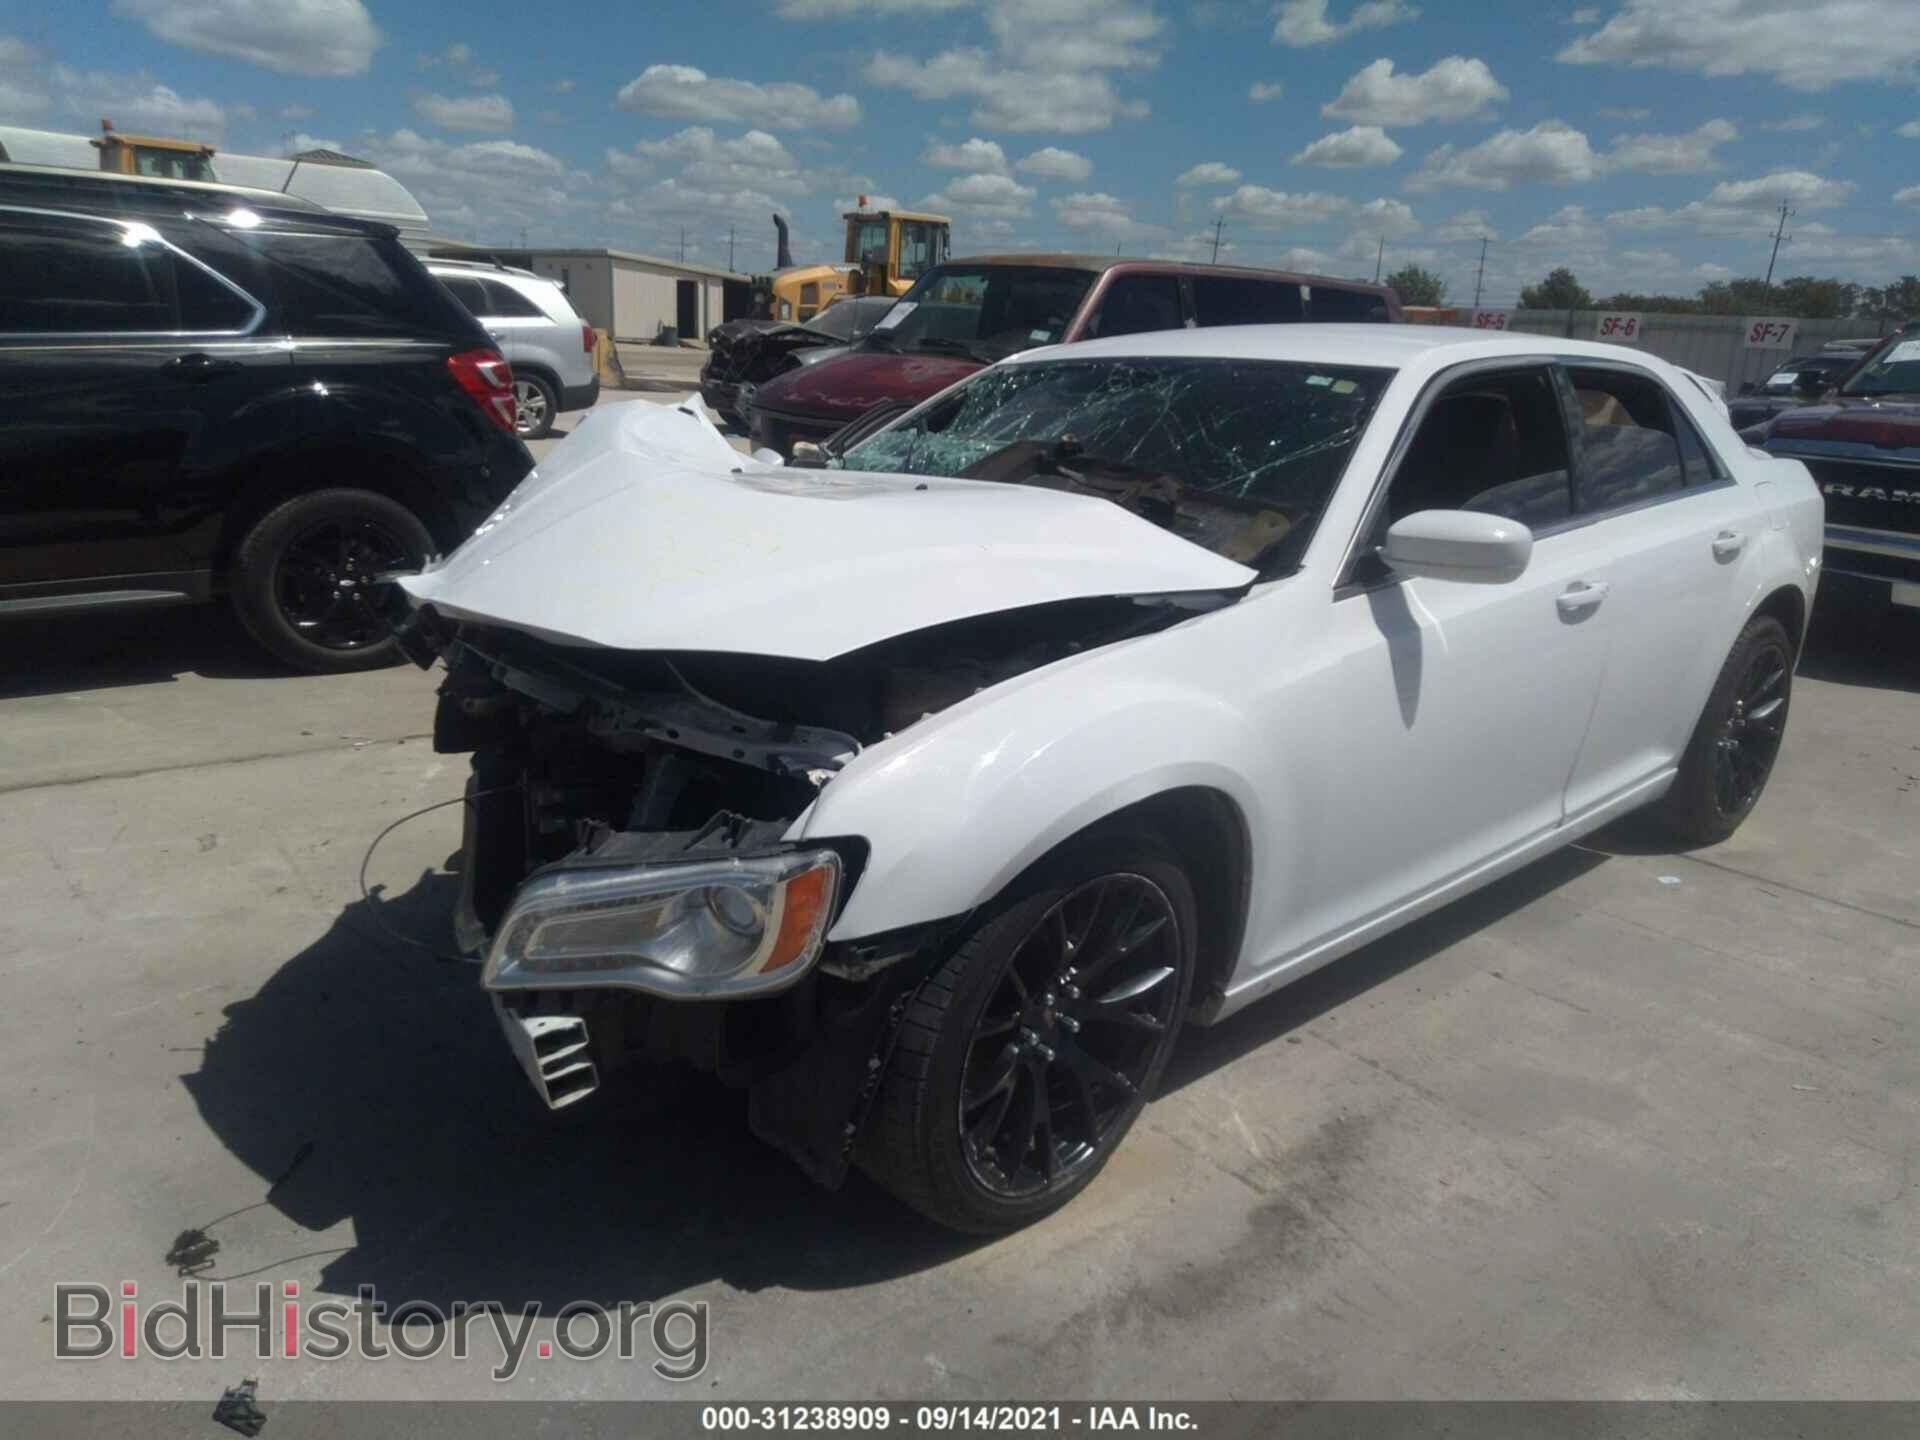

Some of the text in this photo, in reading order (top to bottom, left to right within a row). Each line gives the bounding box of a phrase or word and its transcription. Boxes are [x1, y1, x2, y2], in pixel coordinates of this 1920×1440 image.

[1476, 312, 1505, 329] SF-5
[1600, 317, 1636, 336] SF-6
[1750, 322, 1791, 343] SF-7
[1822, 483, 1920, 504] RAM
